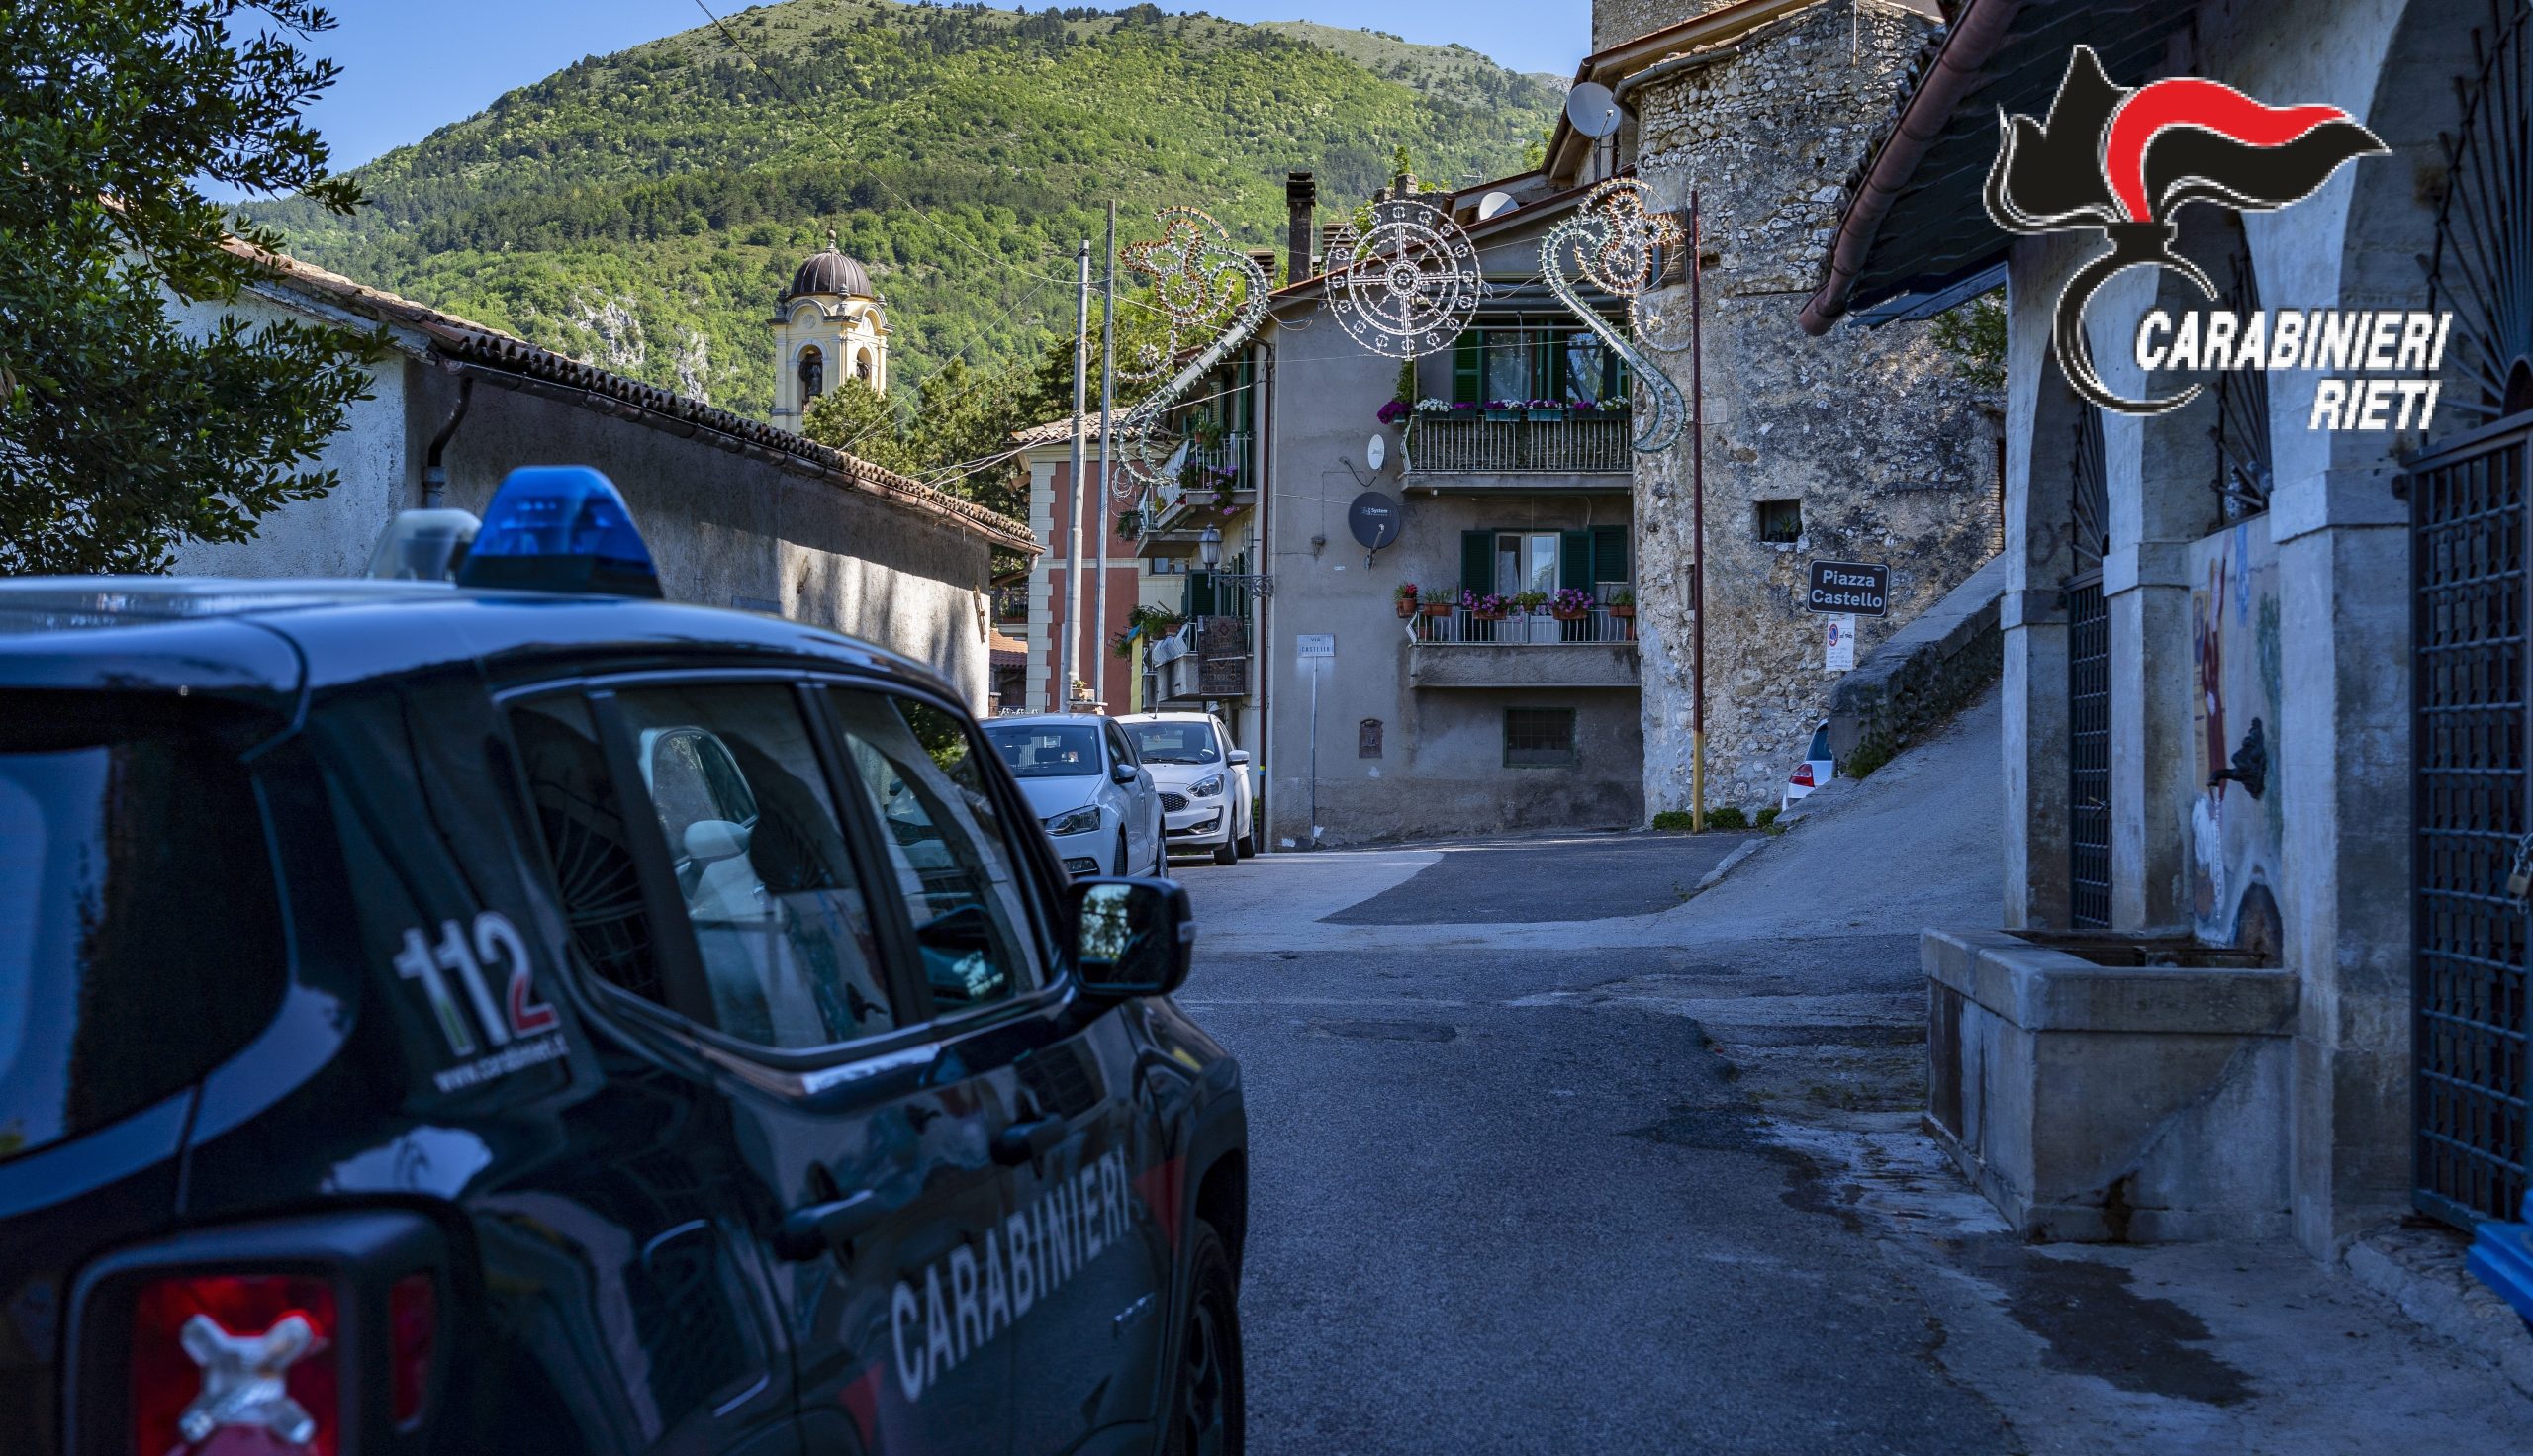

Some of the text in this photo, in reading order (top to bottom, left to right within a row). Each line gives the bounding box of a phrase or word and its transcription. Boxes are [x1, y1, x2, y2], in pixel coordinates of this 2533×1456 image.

[1811, 589, 1883, 608] Castello
[1823, 569, 1876, 588] Piazza
[394, 911, 560, 1057] 112
[891, 1143, 1130, 1404] CARABINIERI
